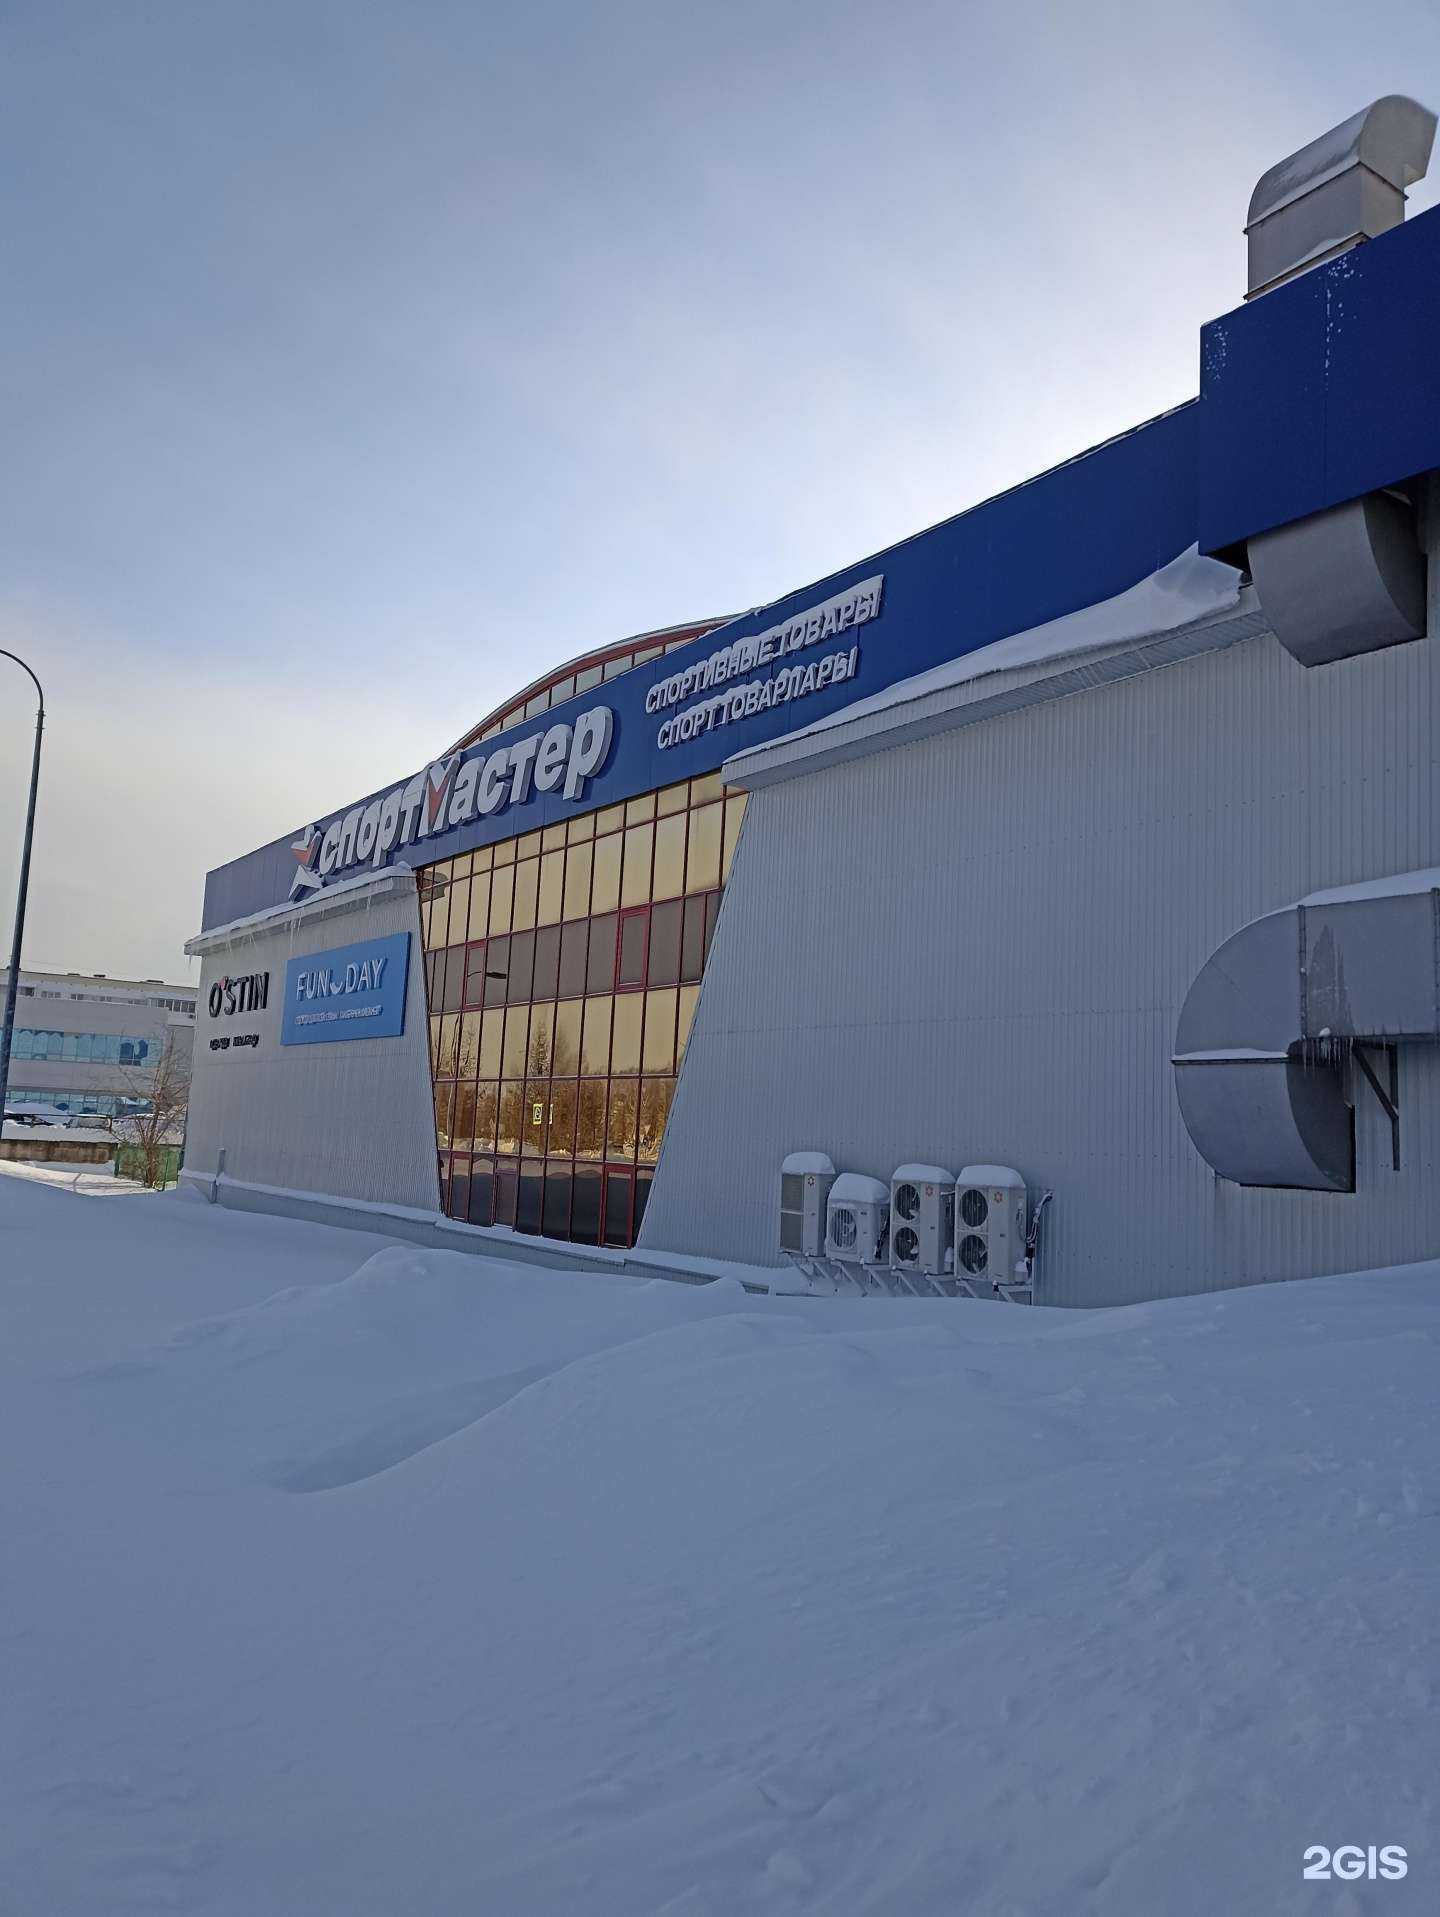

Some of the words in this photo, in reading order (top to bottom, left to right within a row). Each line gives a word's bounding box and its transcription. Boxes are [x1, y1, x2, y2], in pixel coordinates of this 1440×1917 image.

[646, 634, 775, 714] СПОРТИВНЫЕ
[777, 581, 884, 656] ТОВАРЫ
[657, 701, 718, 750] СПОРТ
[295, 968, 333, 1000] FUN
[346, 957, 386, 992] DAY
